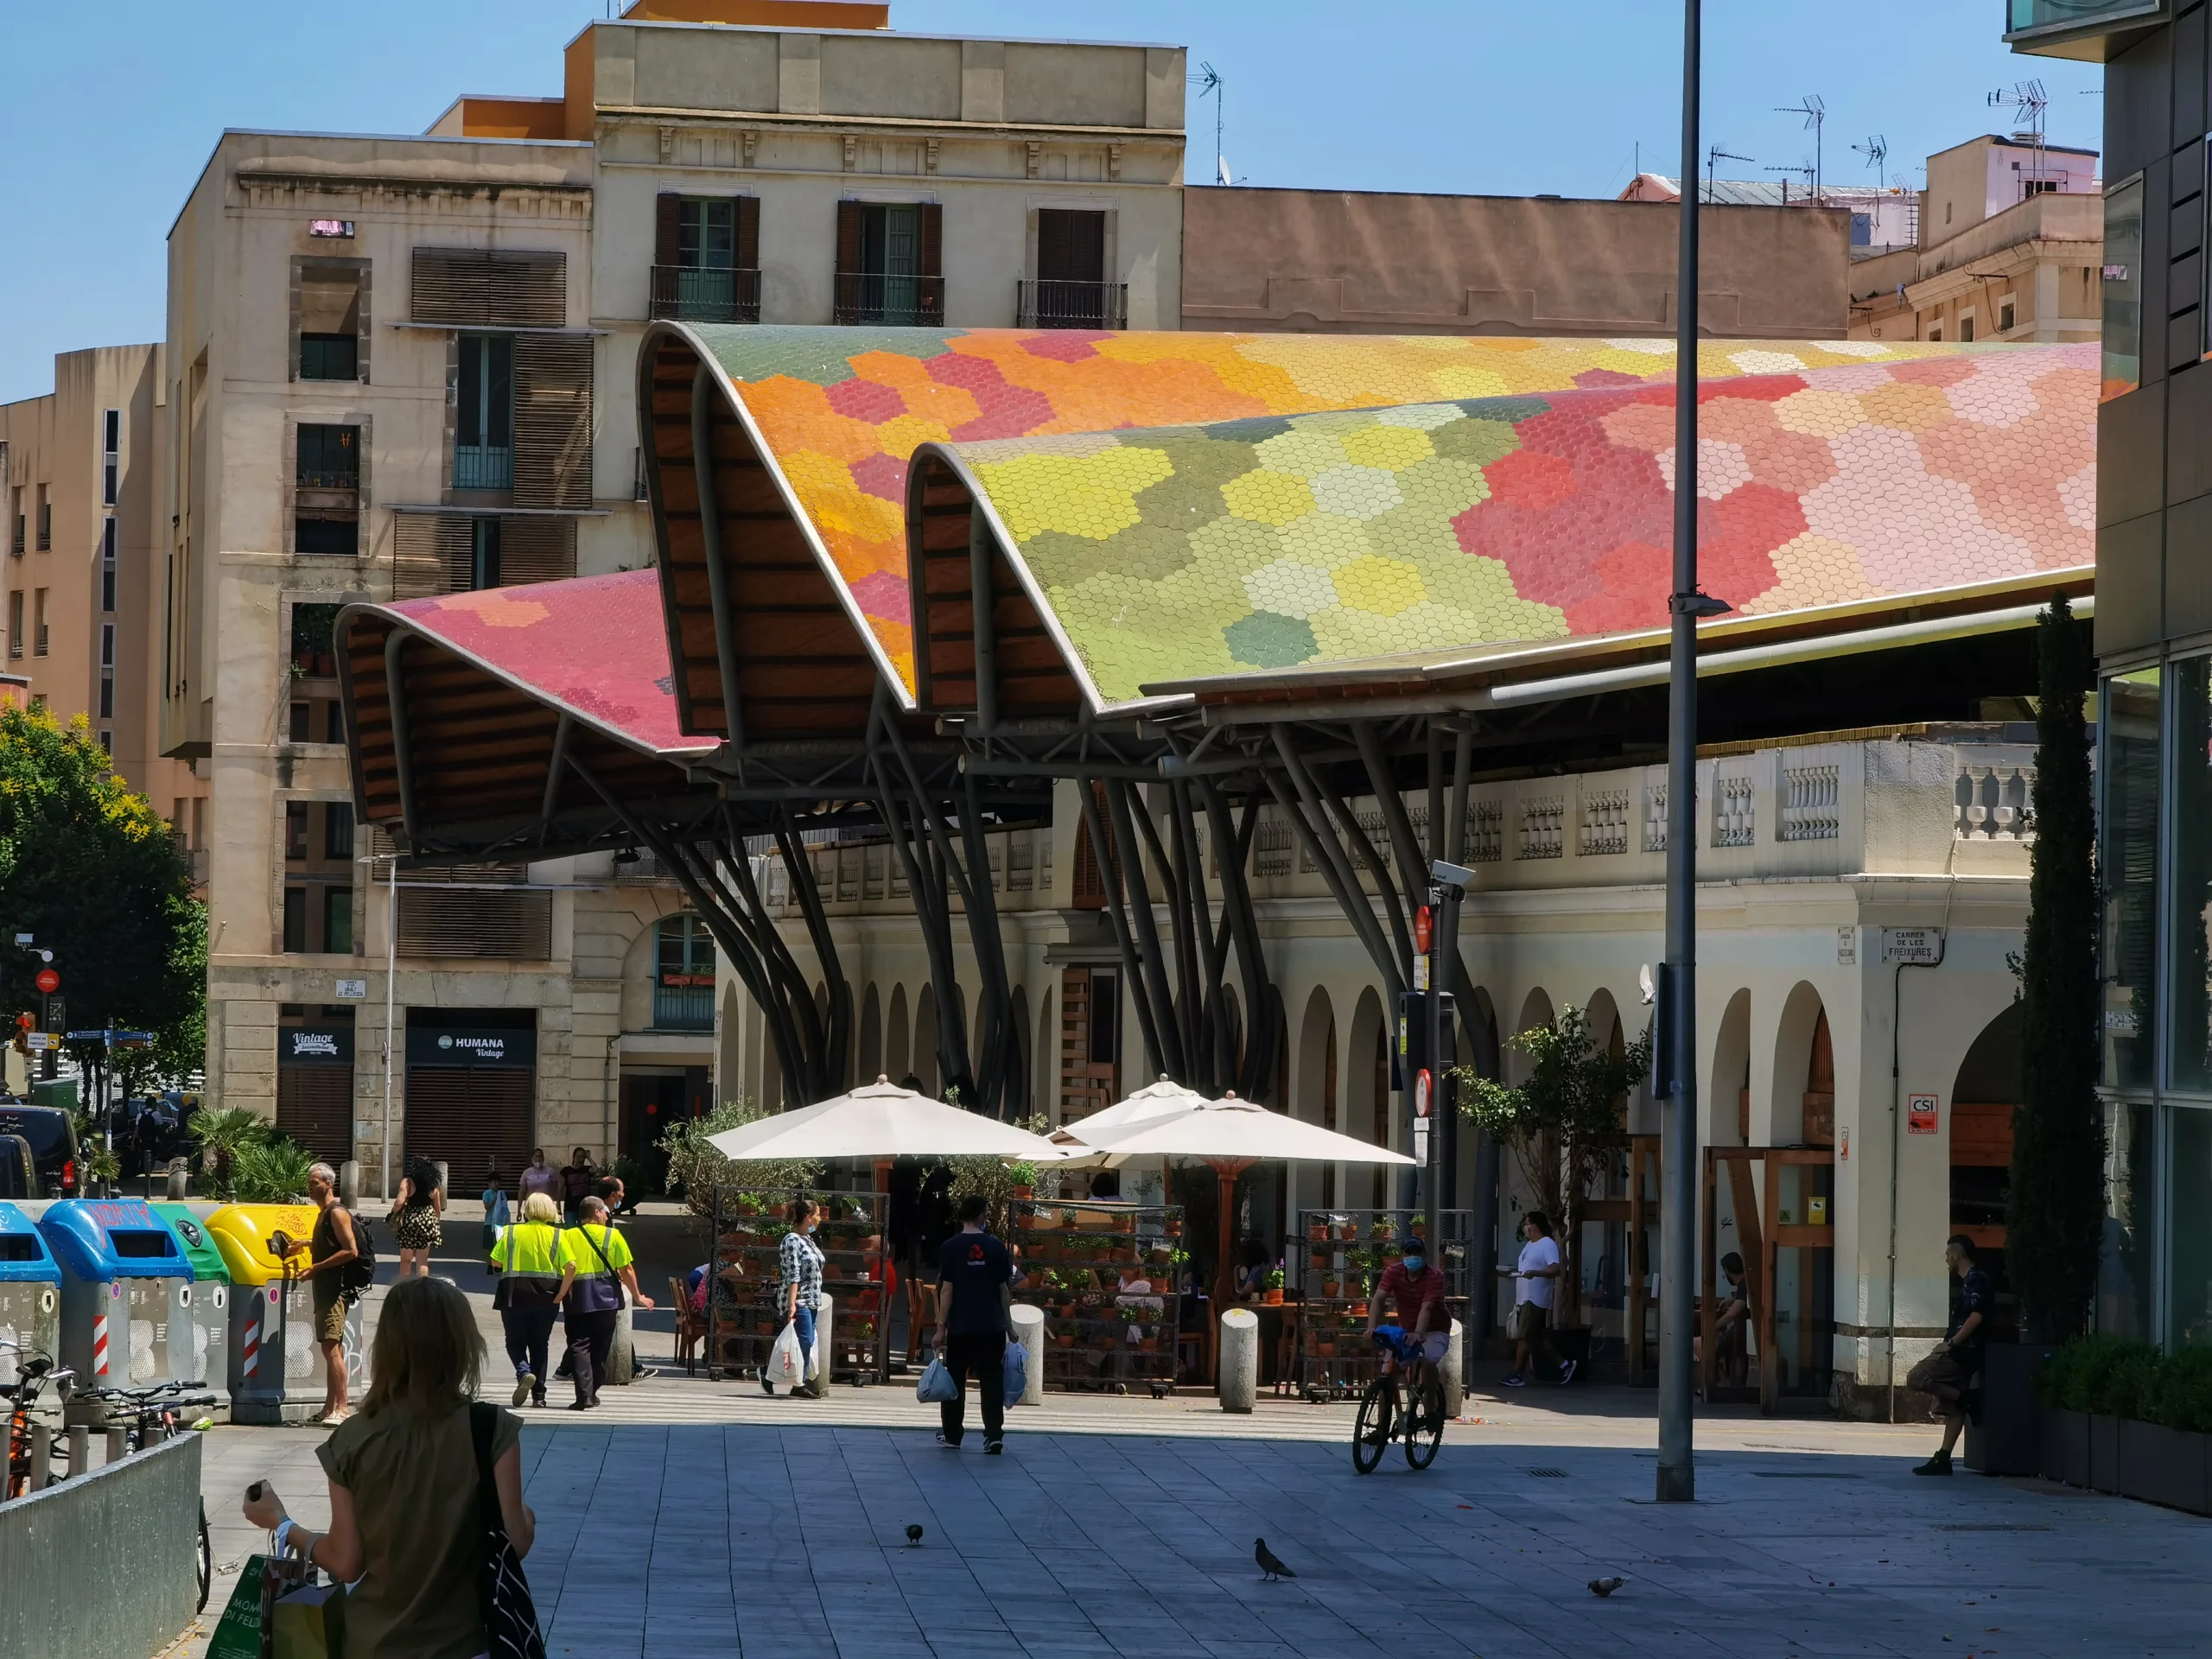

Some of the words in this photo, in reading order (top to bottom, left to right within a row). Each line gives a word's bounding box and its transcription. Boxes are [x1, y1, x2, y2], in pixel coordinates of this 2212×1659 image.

[1889, 948, 1932, 957] FREIXURES
[292, 1033, 334, 1046] Vintage
[455, 1038, 505, 1048] HUMANA
[475, 1048, 505, 1059] Vintage
[1913, 1099, 1934, 1112] CSI
